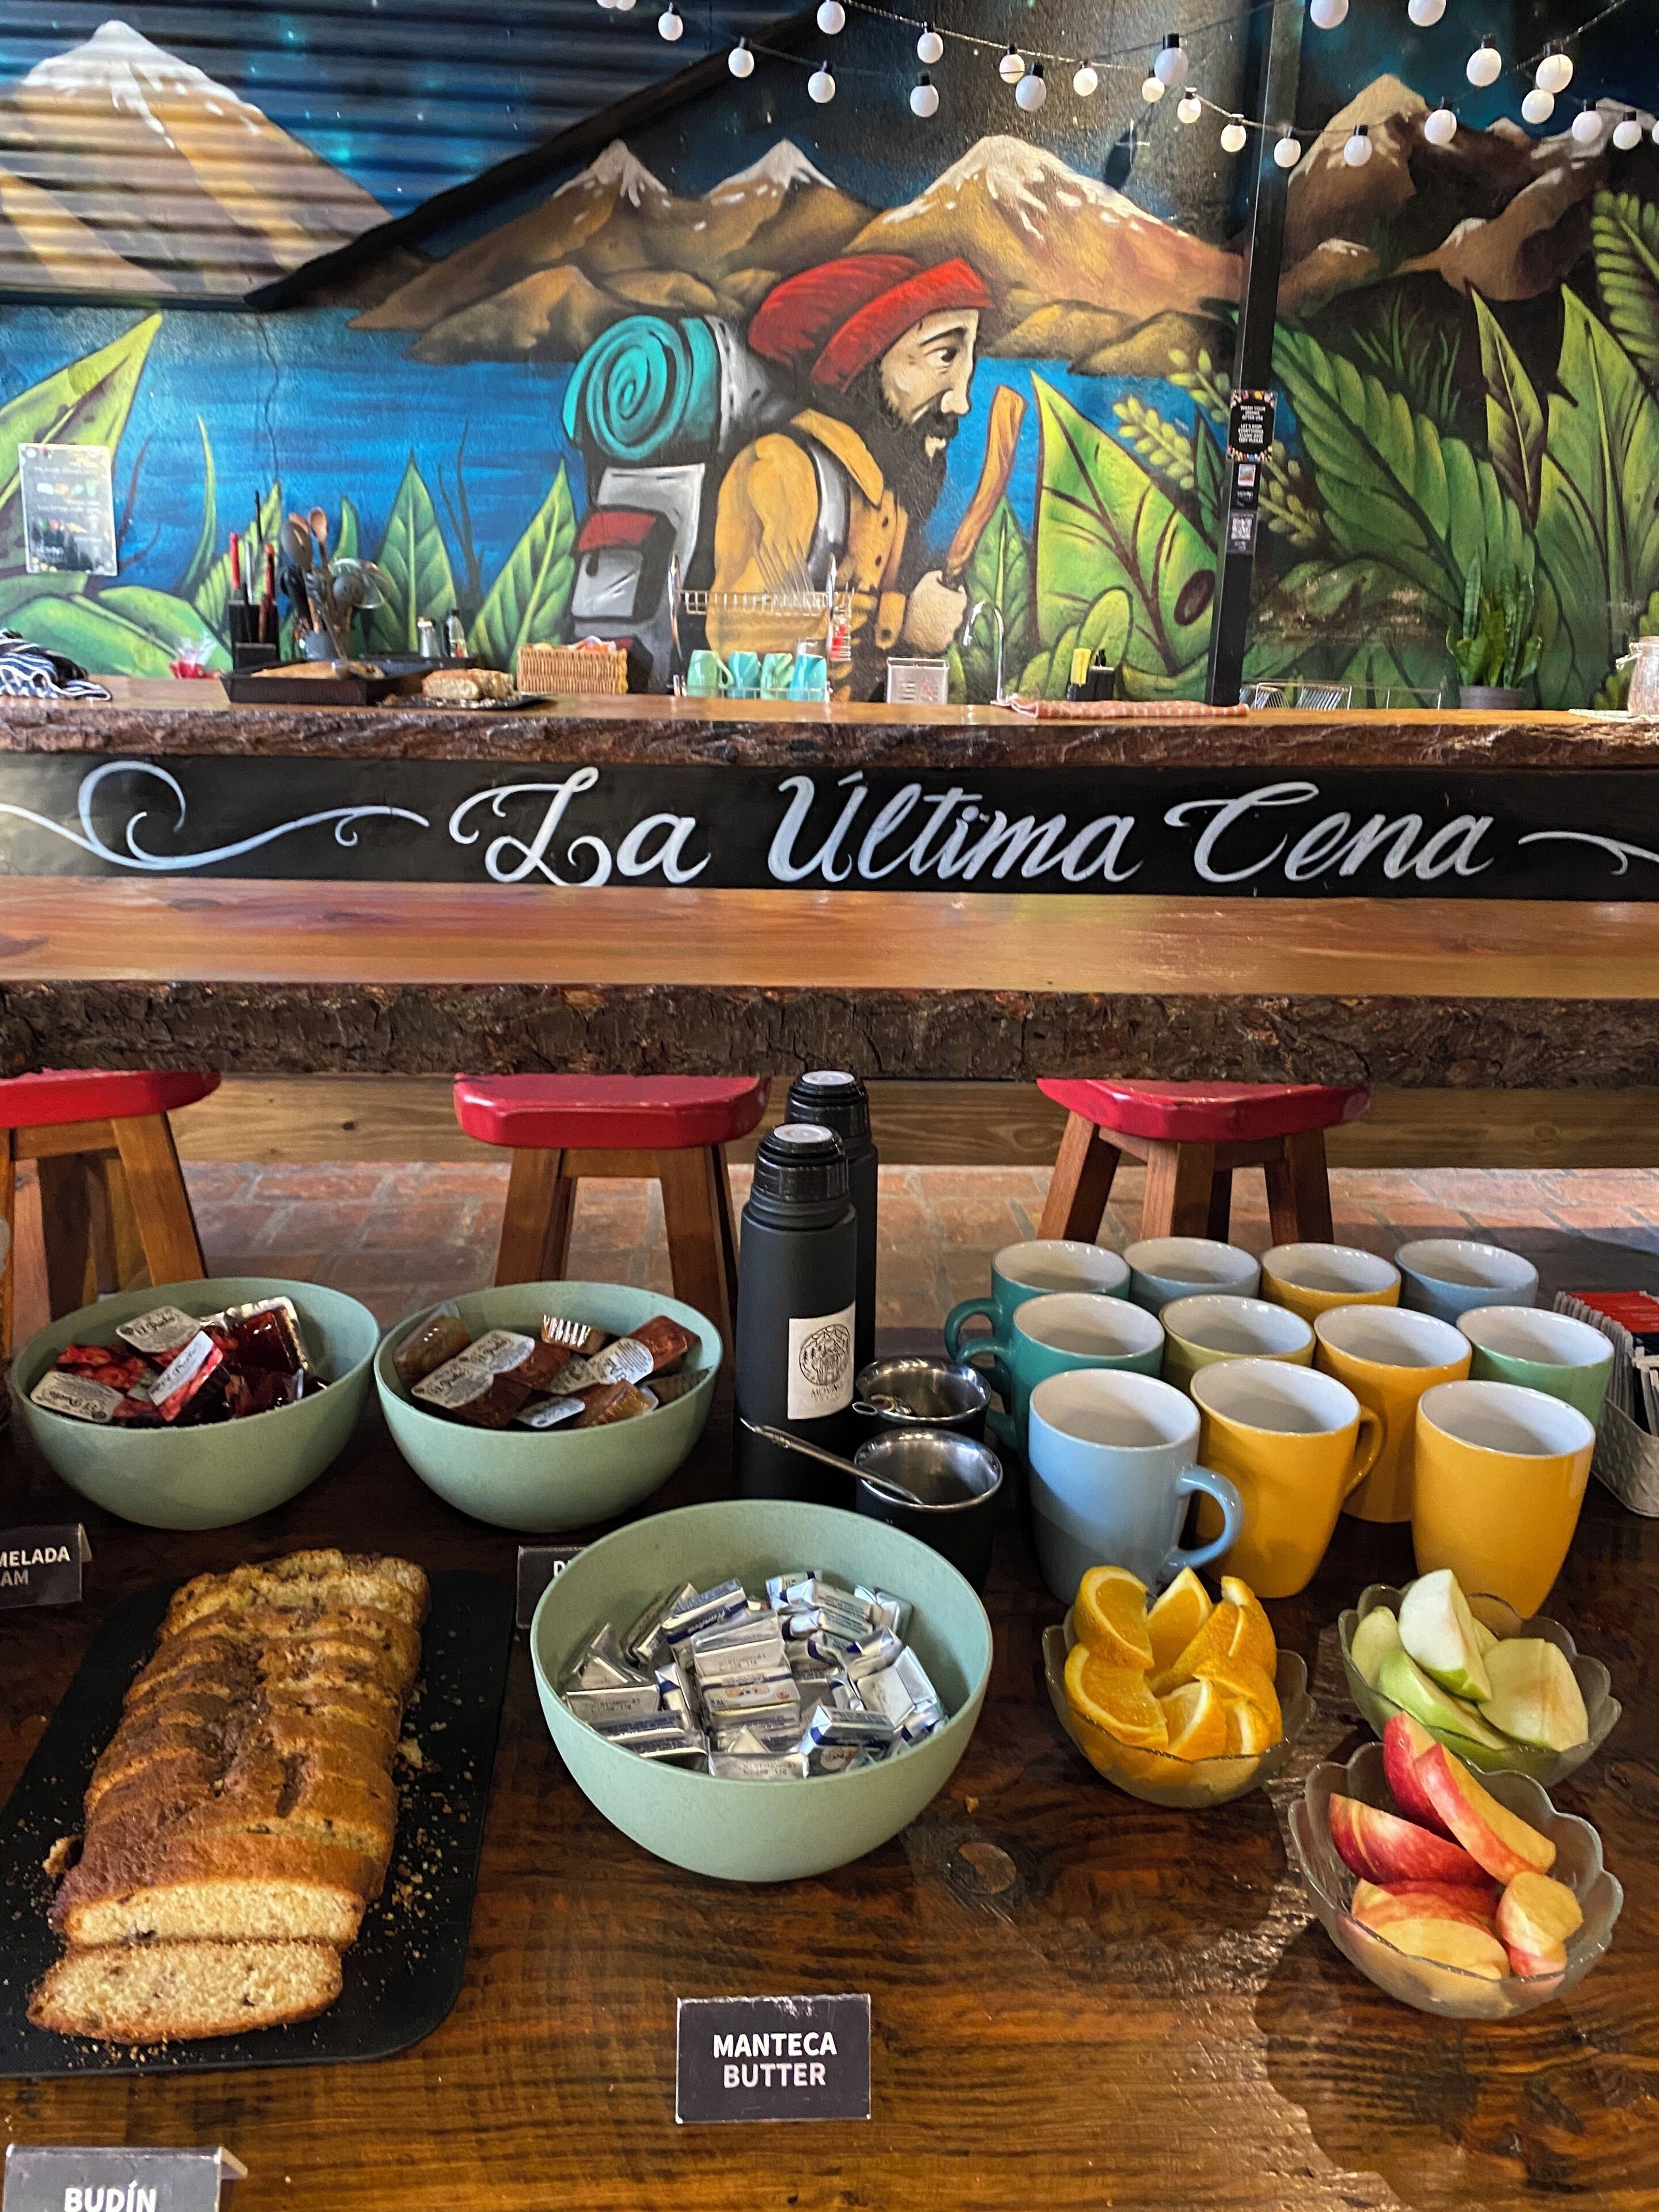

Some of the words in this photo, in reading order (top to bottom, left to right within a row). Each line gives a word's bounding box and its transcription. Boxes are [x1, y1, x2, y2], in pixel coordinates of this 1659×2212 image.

[448, 766, 712, 887] La
[768, 770, 1143, 882] Última
[1164, 781, 1494, 883] Cena
[713, 2031, 838, 2058] MANTECA
[724, 2062, 826, 2088] BUTTER
[63, 2180, 157, 2212] BUDÍN
